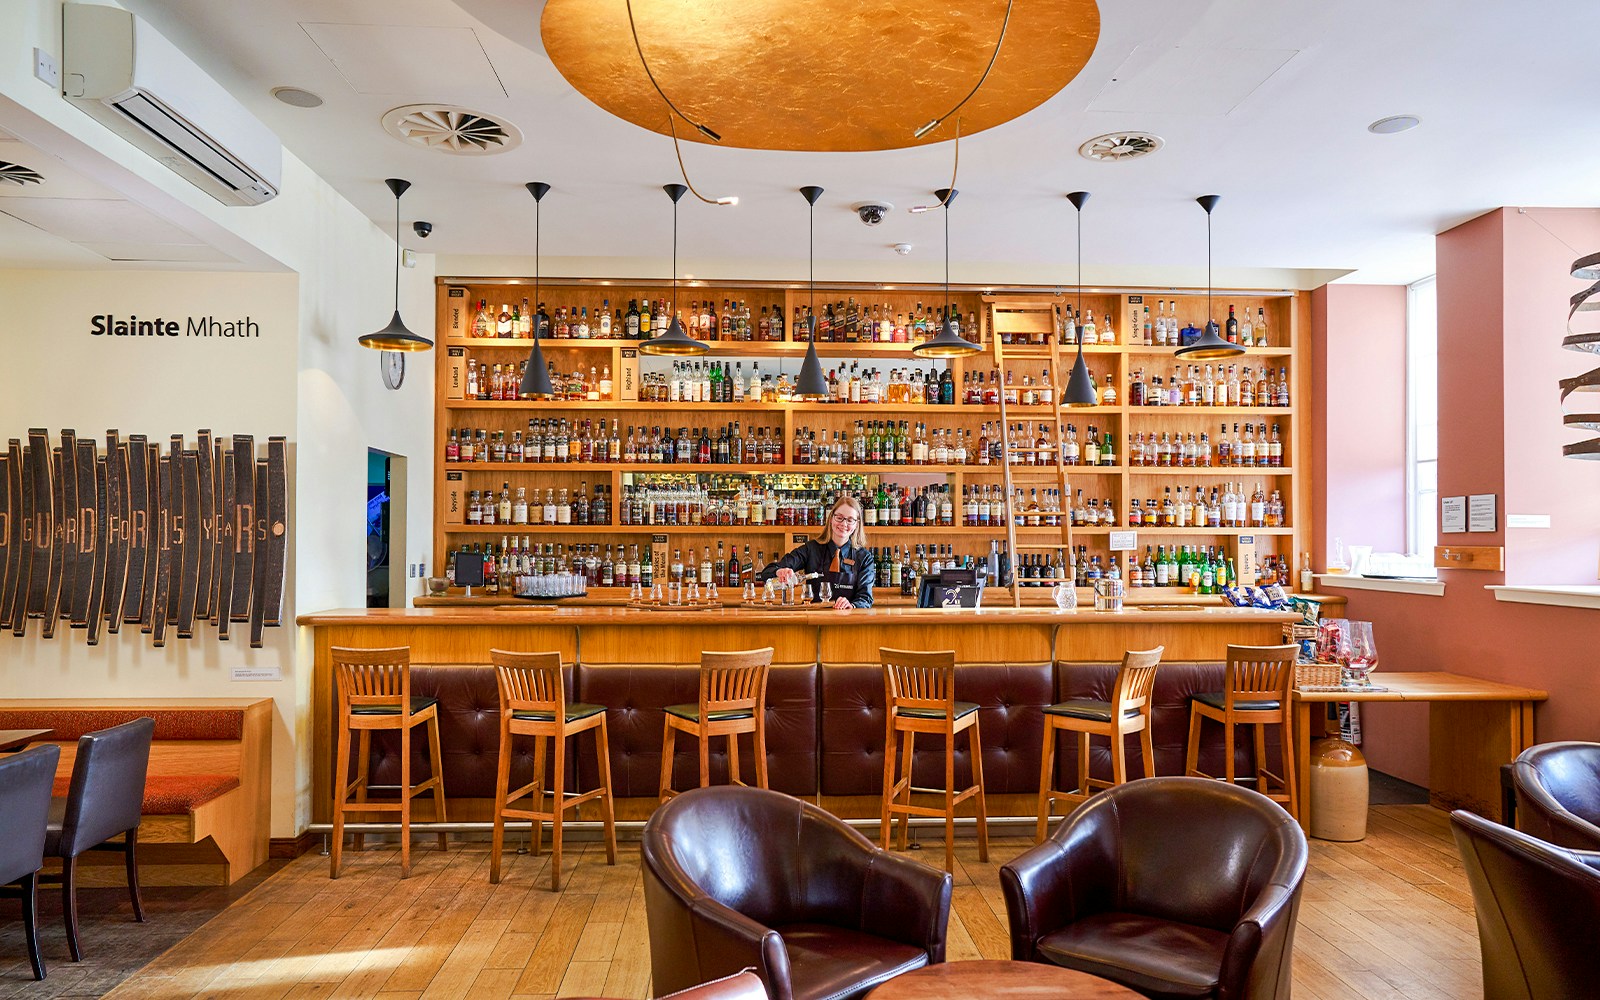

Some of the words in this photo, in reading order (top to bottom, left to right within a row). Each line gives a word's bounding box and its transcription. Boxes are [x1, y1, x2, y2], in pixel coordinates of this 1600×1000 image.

[90, 314, 180, 337] Slainte
[186, 315, 259, 338] Mhath
[450, 490, 458, 513] Speyside
[161, 508, 183, 551] 15
[203, 504, 267, 554] YEARS
